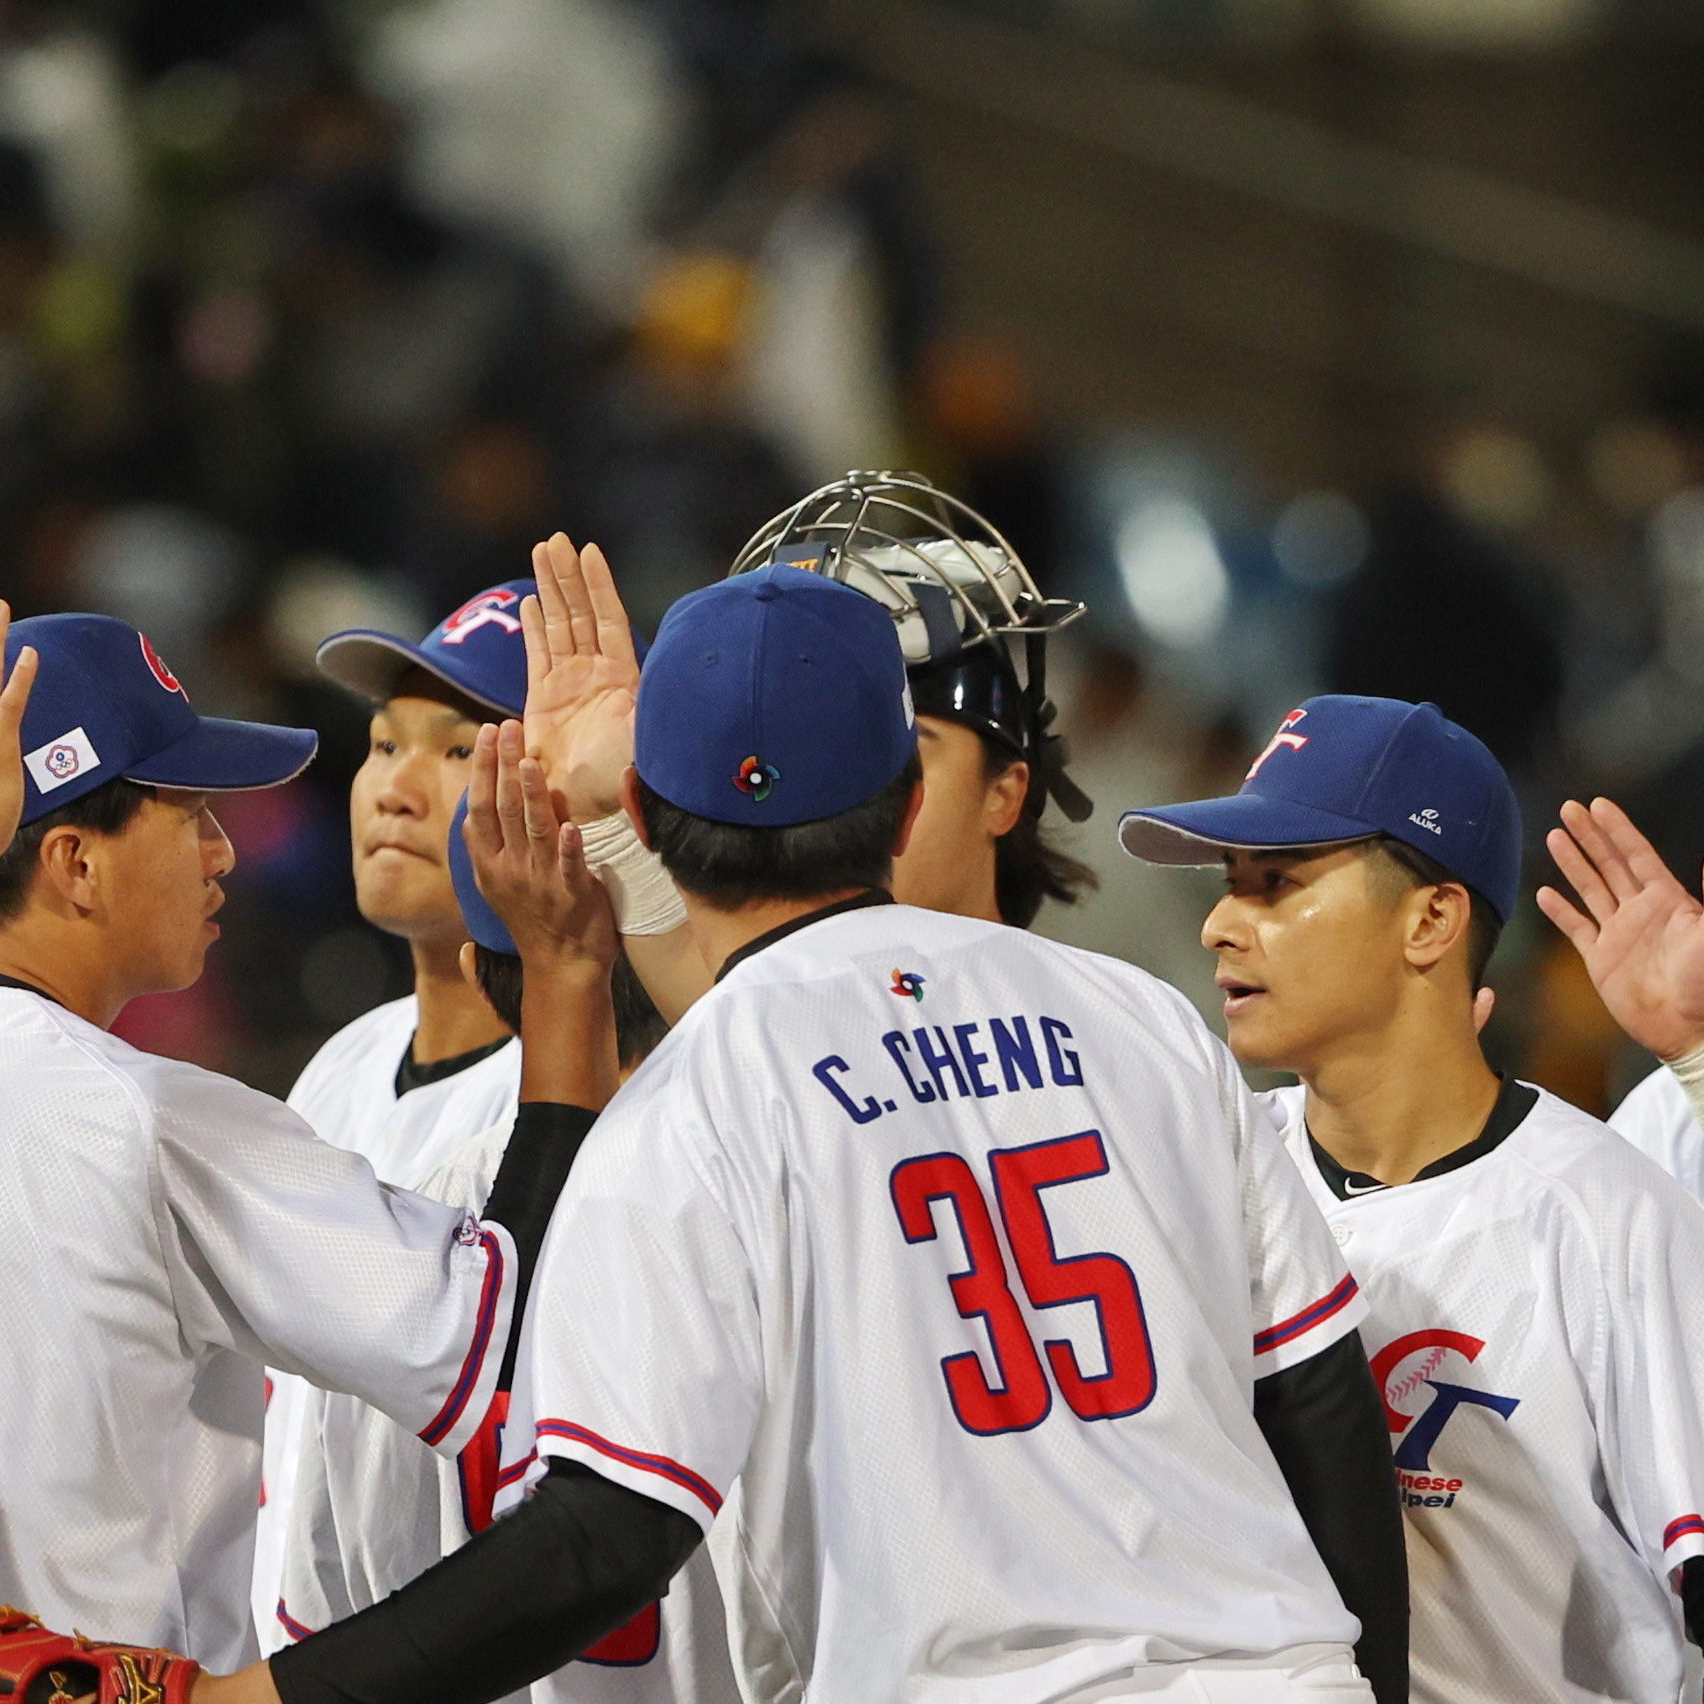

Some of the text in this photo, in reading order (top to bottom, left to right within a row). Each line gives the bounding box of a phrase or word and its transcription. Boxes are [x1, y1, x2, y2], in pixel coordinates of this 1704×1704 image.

[1407, 812, 1443, 837] ALUKA
[812, 1015, 1085, 1125] C. CHENG
[889, 1129, 1157, 1437] 35
